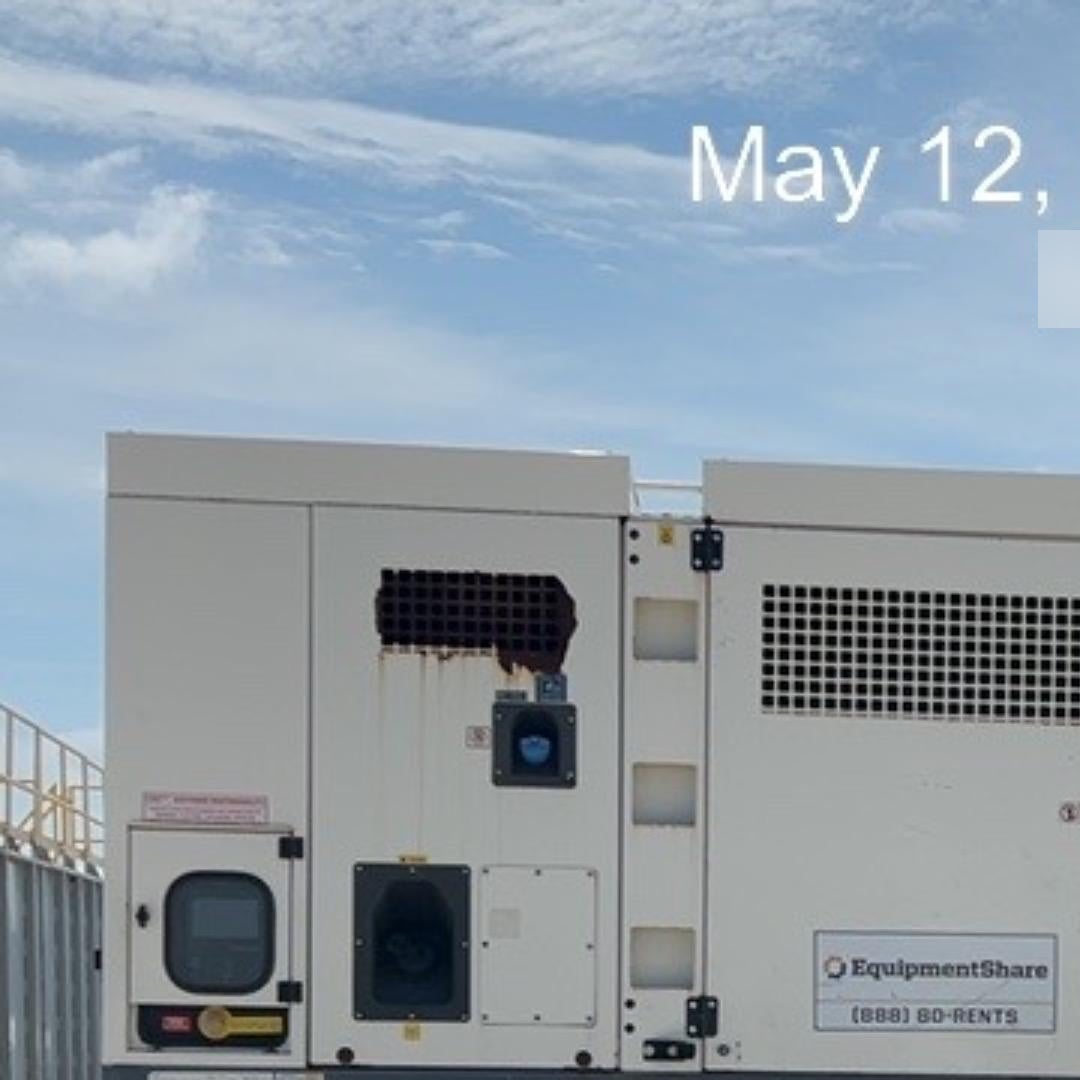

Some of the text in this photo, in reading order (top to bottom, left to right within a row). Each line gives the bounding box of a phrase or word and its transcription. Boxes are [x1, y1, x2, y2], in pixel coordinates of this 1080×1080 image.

[851, 959, 1048, 981] EquipmentShare
[851, 1005, 1018, 1025] (888) 80-RENTS
